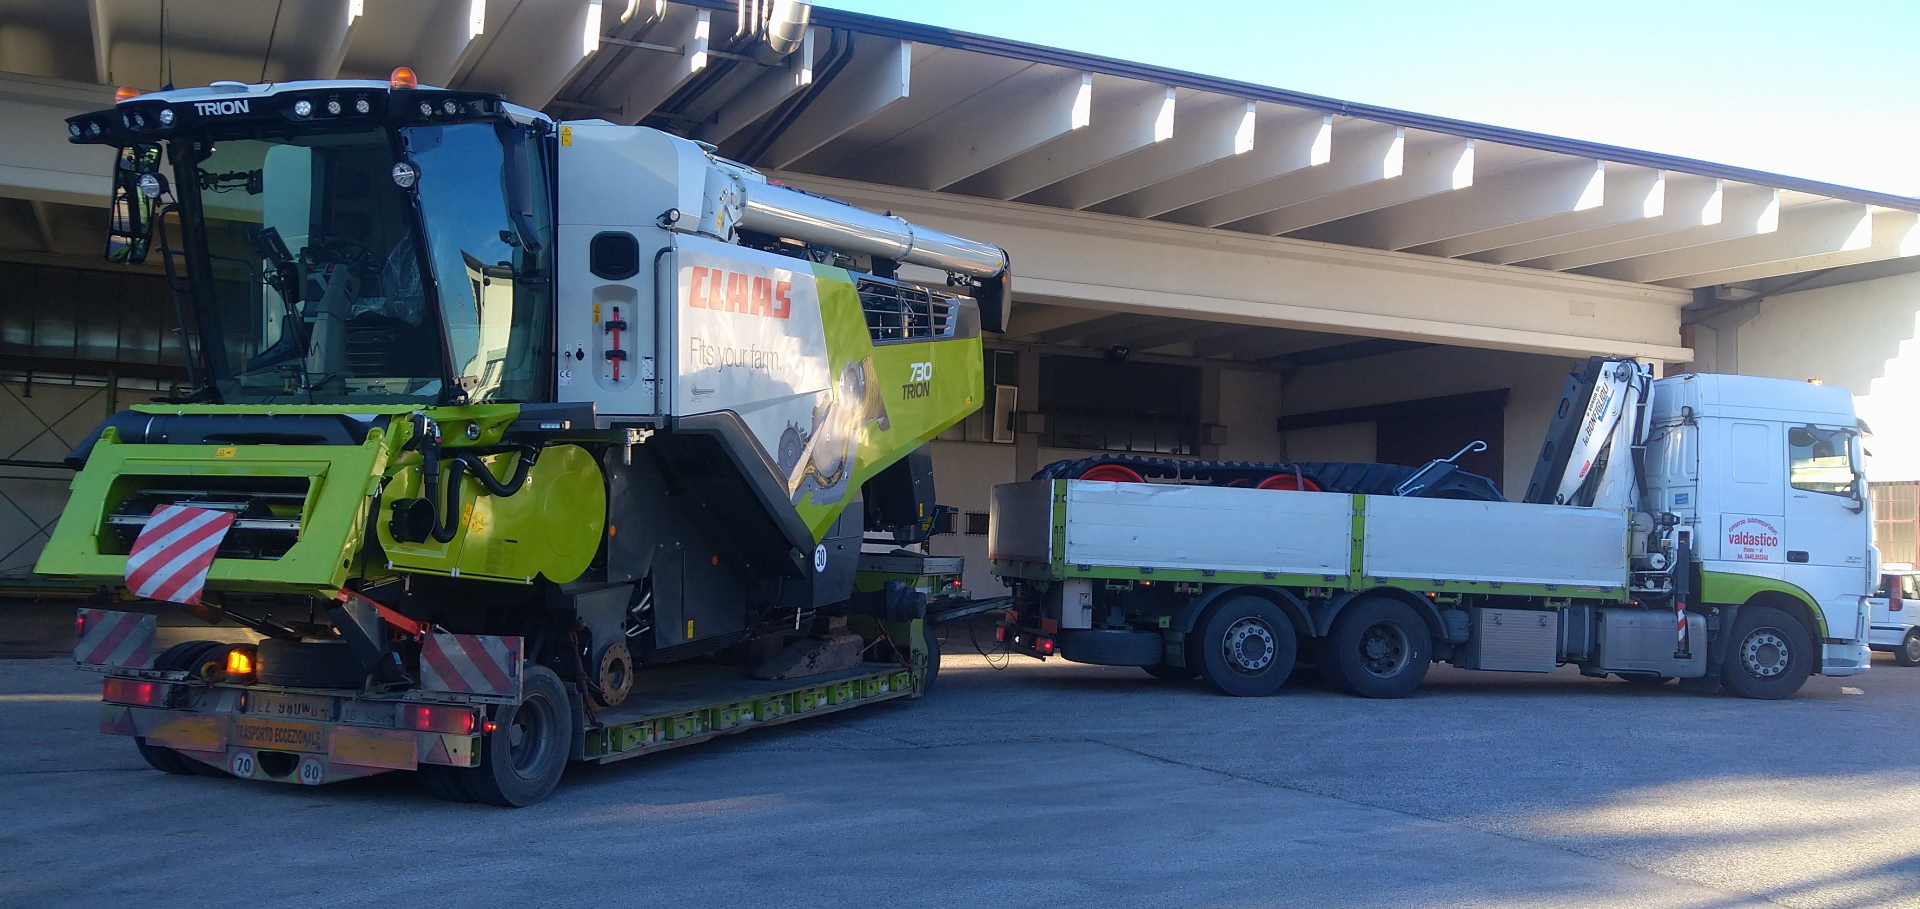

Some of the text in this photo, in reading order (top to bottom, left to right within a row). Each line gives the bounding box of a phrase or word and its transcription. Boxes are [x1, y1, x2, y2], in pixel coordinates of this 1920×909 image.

[194, 99, 250, 116] TRION
[688, 266, 792, 319] CLAAS
[690, 337, 782, 373] Fits your farm.
[910, 361, 932, 383] 730
[902, 381, 930, 400] TRION
[1728, 531, 1778, 547] valdastico
[816, 549, 825, 567] 30
[275, 727, 321, 746] ECCEZIONALE
[237, 757, 251, 773] 70
[304, 764, 319, 779] 80
